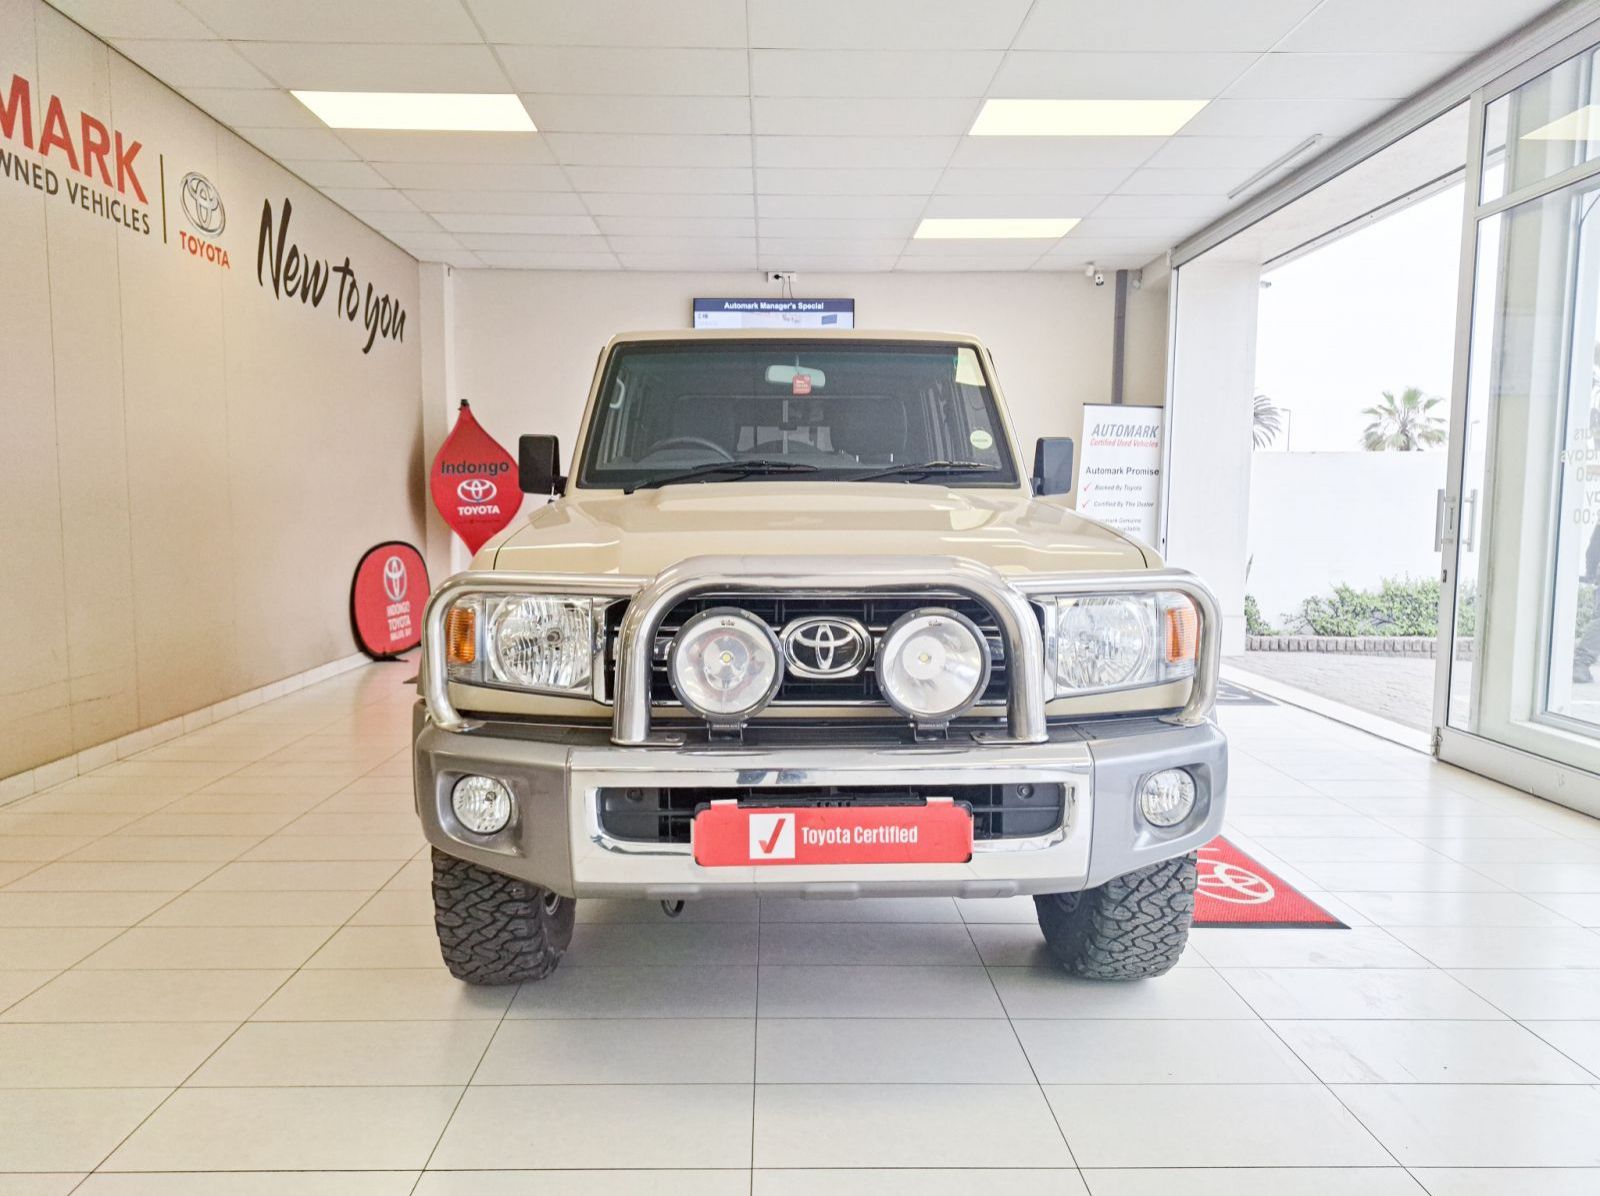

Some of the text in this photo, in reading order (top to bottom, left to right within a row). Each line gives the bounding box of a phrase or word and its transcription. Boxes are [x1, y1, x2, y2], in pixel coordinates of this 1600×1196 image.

[0, 74, 149, 205] MARK
[66, 178, 150, 235] VEHICLES
[179, 231, 231, 269] TOYOTA
[257, 197, 406, 354] New to you
[724, 302, 825, 311] Automark Manager's Special
[1091, 423, 1160, 438] AUTOMARK
[1086, 466, 1160, 476] Automark Promise
[457, 505, 500, 516] TOYOTA
[801, 826, 918, 846] Toyota Certified
